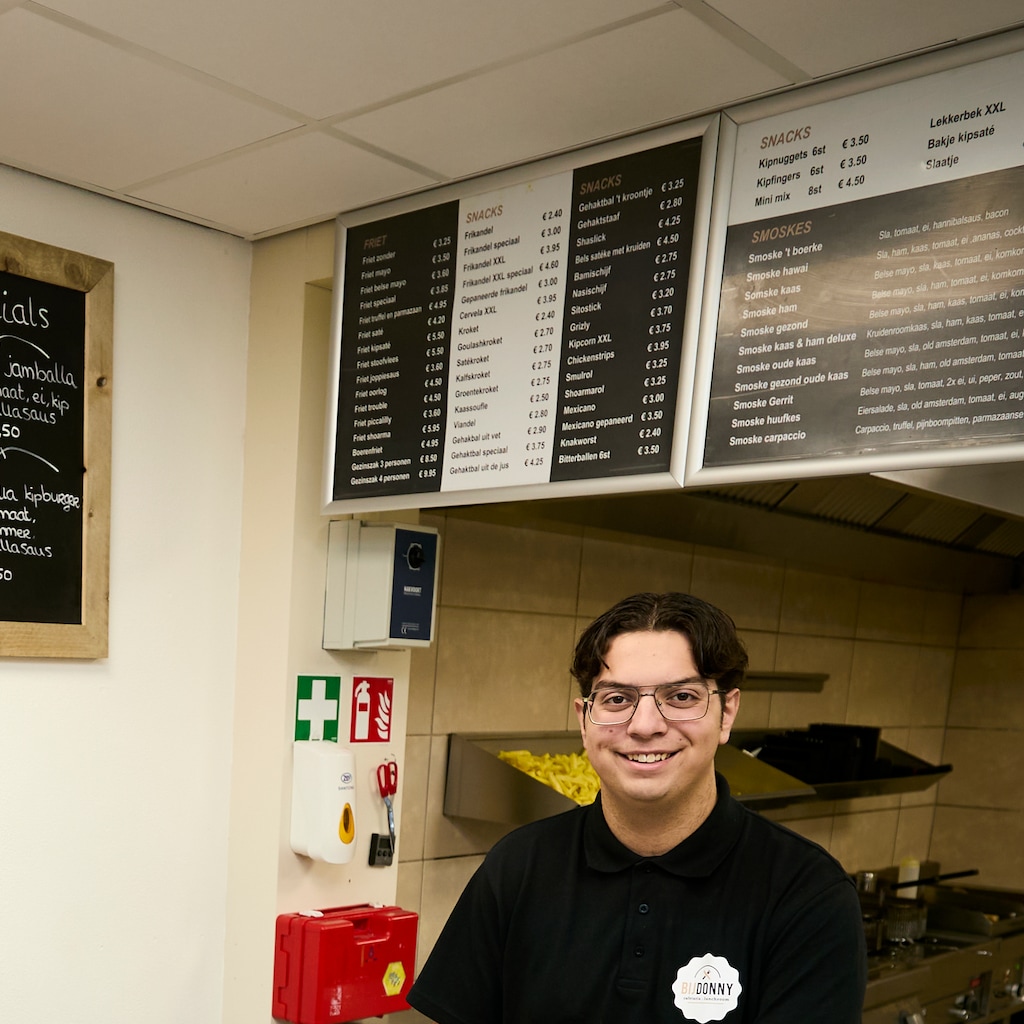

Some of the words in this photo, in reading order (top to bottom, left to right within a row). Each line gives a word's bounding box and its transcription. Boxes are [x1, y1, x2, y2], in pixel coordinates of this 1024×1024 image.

[930, 107, 982, 128] Lekkerbek
[984, 102, 1006, 116] XXL
[760, 126, 812, 149] SNACKS
[928, 135, 955, 149] Bakje
[958, 125, 995, 143] kipsaté
[759, 151, 808, 169] Kipnuggets
[812, 145, 826, 156] 6st
[851, 135, 869, 147] 3.50
[926, 155, 959, 170] Slaatje
[757, 171, 800, 188] Kipfingers
[810, 165, 824, 176] 6st
[849, 155, 867, 167] 3.50
[580, 174, 622, 195] SNACKS
[755, 196, 772, 207] Mini
[775, 192, 790, 203] mix
[808, 185, 821, 196] 8st
[846, 175, 865, 187] 4.50
[579, 197, 614, 212] Gehaktbal
[622, 187, 653, 202] kroontje
[466, 205, 503, 223] SNACKS
[578, 212, 620, 229] Gehaktstaaf
[985, 208, 1009, 220] bacon
[465, 226, 493, 240] Frikandel
[576, 233, 606, 246] Shaslick
[752, 221, 812, 243] SMOSKES
[364, 235, 387, 250] FRIET
[464, 243, 492, 256] Frikandel
[494, 236, 520, 249] speciaal
[612, 247, 624, 256] met
[626, 241, 650, 253] kruiden
[362, 256, 375, 265] Friet
[376, 251, 396, 262] zonder
[748, 250, 783, 263] Smoske
[792, 243, 822, 255] boerke
[463, 258, 491, 272] Frikandel
[493, 256, 506, 266] XXL
[463, 275, 491, 288] Frikandel
[492, 273, 505, 282] XXL
[507, 266, 534, 279] speciaal
[574, 266, 611, 281] Bamischijf
[747, 268, 780, 282] Smoske
[783, 263, 808, 276] hawai
[461, 289, 498, 304] Gepaneerde
[500, 284, 527, 296] frikandel
[573, 283, 607, 298] Nasischijf
[745, 288, 778, 301] Somske
[781, 285, 801, 297] kaas
[460, 308, 482, 319] Cervela
[484, 306, 497, 315] XXL
[571, 302, 601, 315] Sitostick
[743, 307, 776, 319] Smoske
[779, 304, 797, 313] ham
[458, 326, 479, 335] Kroket
[570, 322, 590, 332] Grizly
[740, 325, 774, 337] Smoske
[776, 320, 808, 334] gezond
[457, 337, 503, 351] Goulashkroket
[568, 337, 596, 349] Kipcorn
[598, 334, 612, 344] XXL
[739, 344, 772, 356] Smoske
[774, 341, 794, 351] kaas
[796, 339, 803, 348] &
[806, 338, 824, 347] ham
[827, 332, 856, 344] deluxe
[456, 355, 489, 367] Satékroket
[568, 351, 614, 365] Chickenstrips
[736, 362, 770, 374] Smoske
[772, 359, 793, 370] oude
[796, 357, 816, 366] kaas
[4, 355, 77, 389] jamballa
[456, 371, 490, 383] Kalfskroket
[566, 370, 593, 382] Smulrol
[735, 381, 768, 392] Smoske
[770, 376, 802, 390] gezond
[804, 374, 825, 384] oude
[828, 372, 848, 381] kaas
[455, 385, 498, 398] Groentekroket
[565, 385, 604, 398] Shoarmarol
[51, 392, 70, 416] kip
[563, 404, 596, 414] Mexicano
[734, 399, 767, 410] Smoske
[769, 395, 793, 406] Gerrit
[454, 420, 476, 429] Viandel
[562, 421, 594, 431] Mexicano
[596, 414, 633, 429] gepaneerd
[732, 417, 764, 428] Smoske
[767, 414, 801, 424] huufkes
[560, 436, 597, 447] Knakworst
[729, 436, 762, 446] Smoske
[764, 431, 806, 443] carpaccio
[352, 447, 383, 456] Boerenfriet
[451, 449, 481, 459] Gehaktbal
[482, 446, 508, 457] speciaal
[559, 451, 597, 463] Bitterballen
[599, 451, 610, 459] 6st
[644, 445, 659, 454] 3.50
[450, 464, 480, 474] Gehaktbal
[499, 462, 509, 471] jus
[24, 484, 80, 512] kipburger
